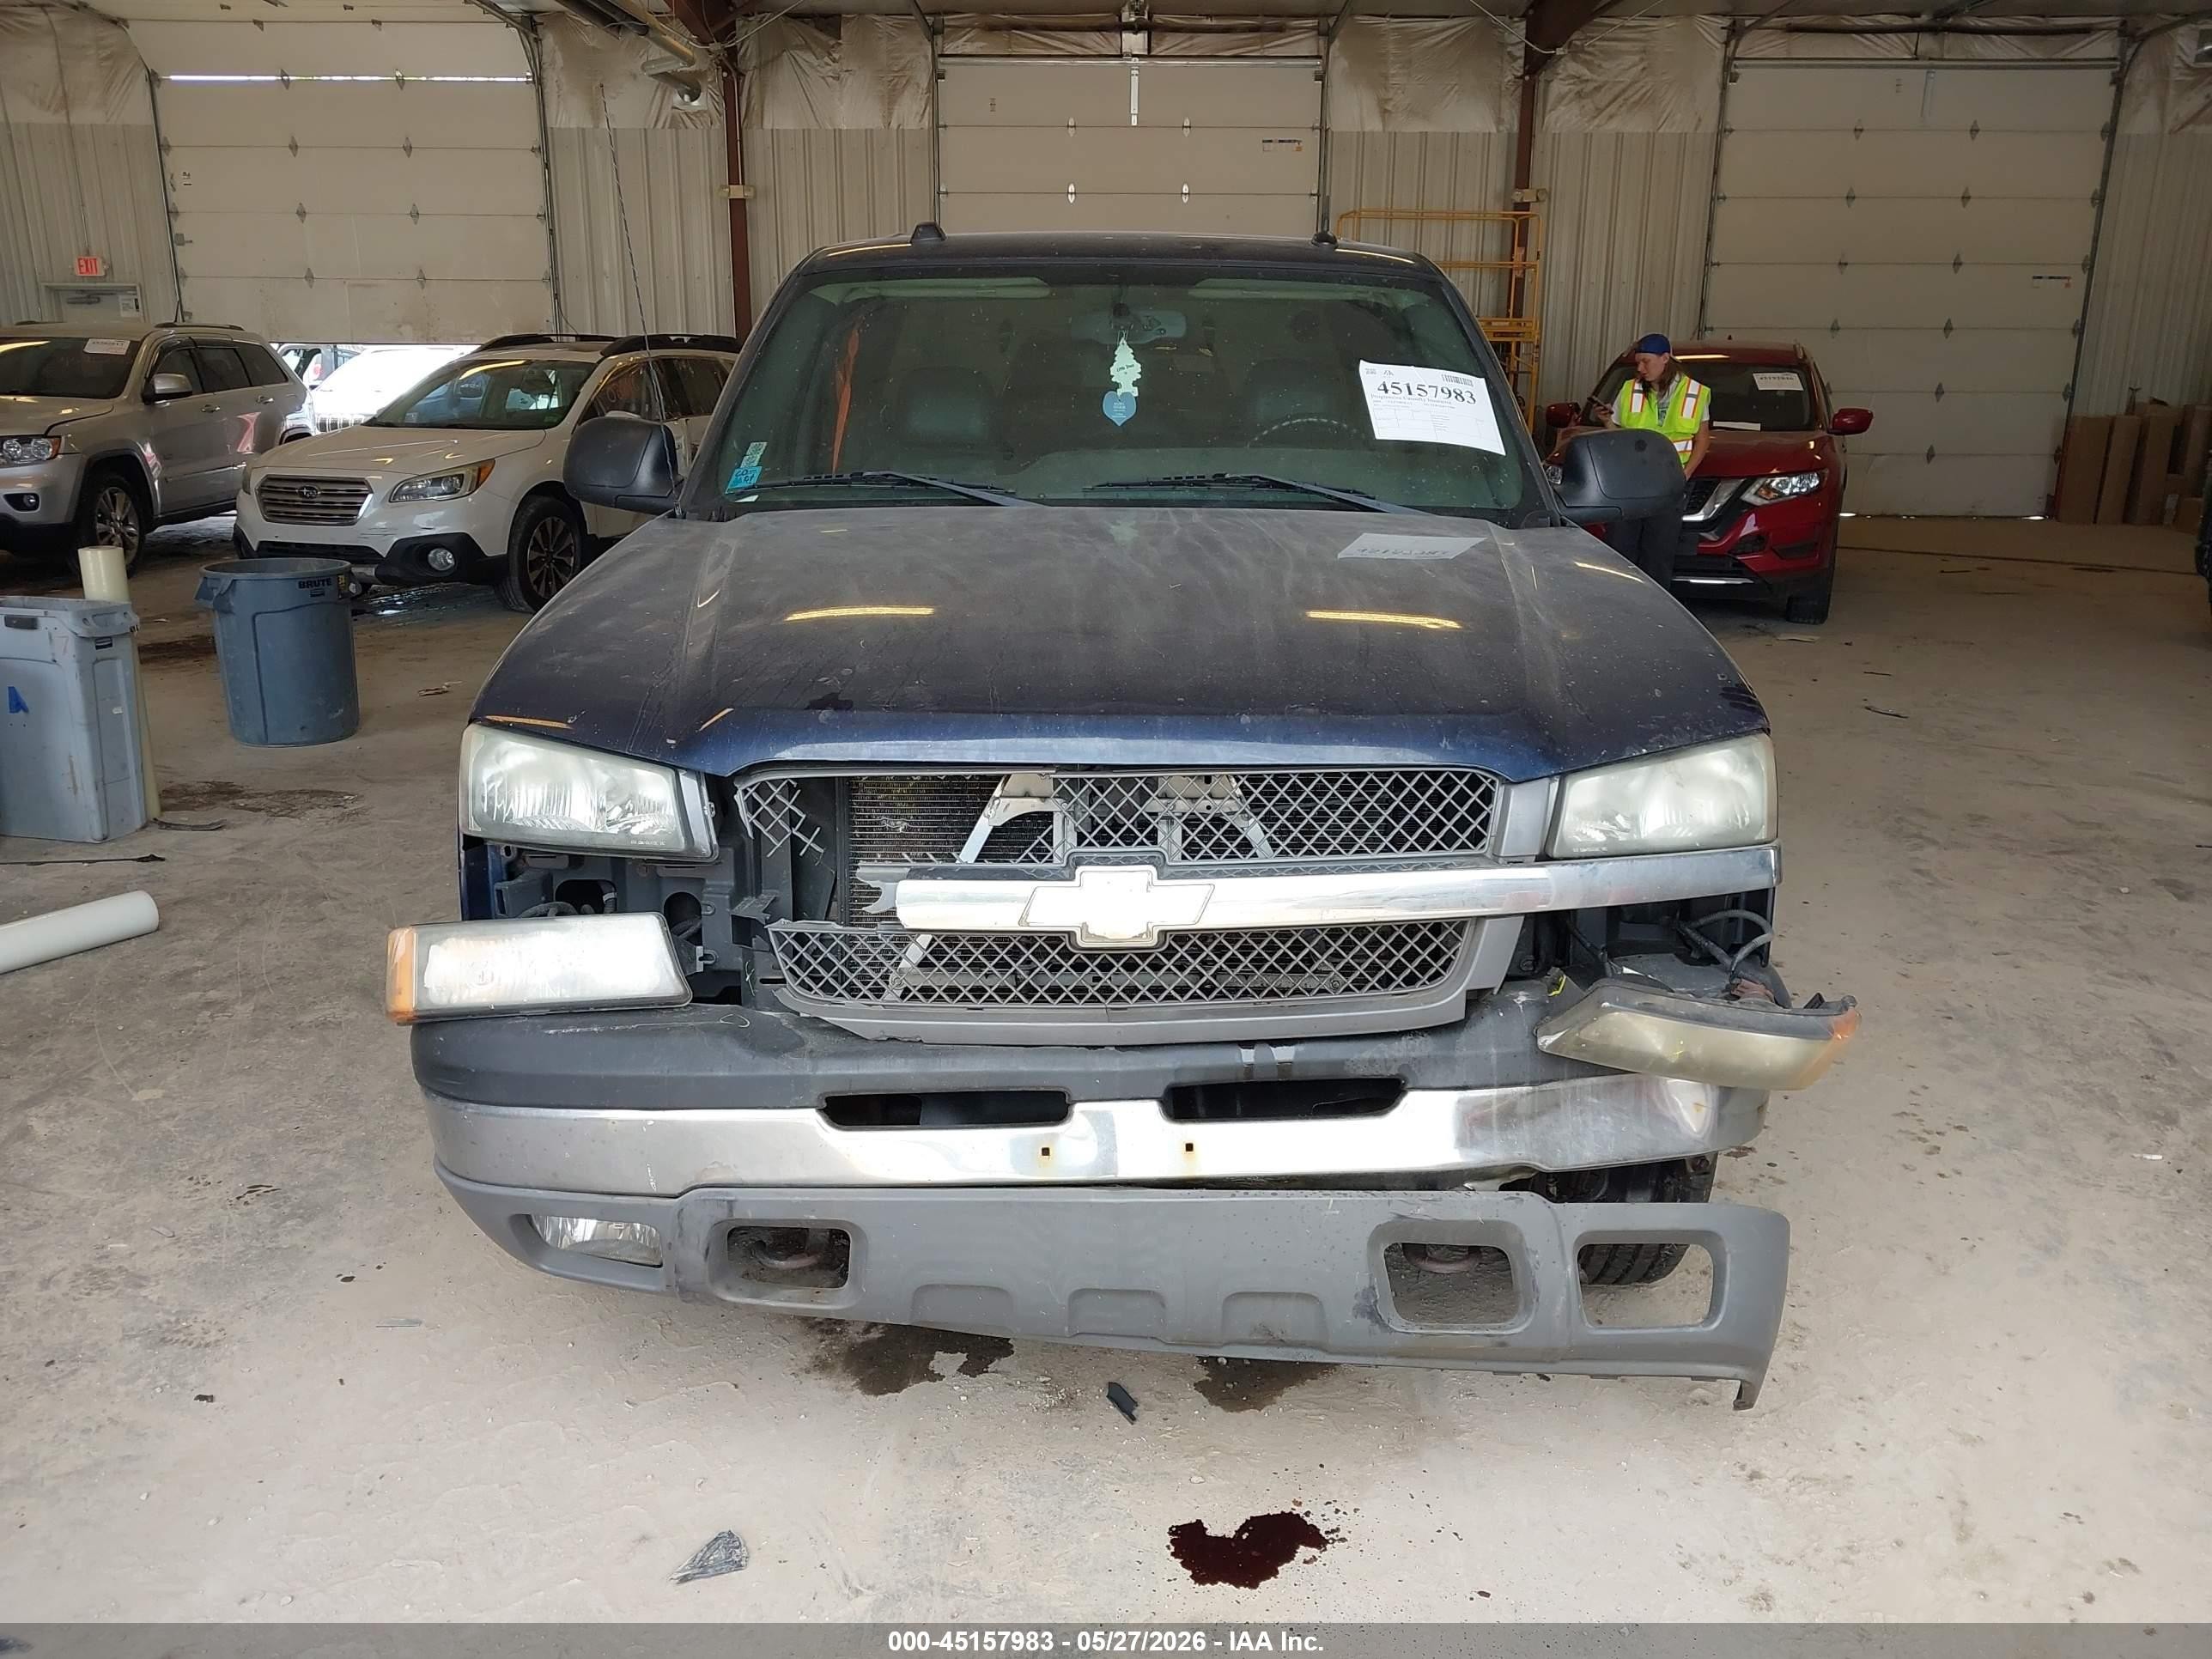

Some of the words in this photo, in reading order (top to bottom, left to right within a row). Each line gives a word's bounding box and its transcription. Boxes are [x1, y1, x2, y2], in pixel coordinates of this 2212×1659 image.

[77, 258, 98, 275] EXIT
[1377, 380, 1477, 405] 45157983
[298, 577, 332, 589] BRUTE
